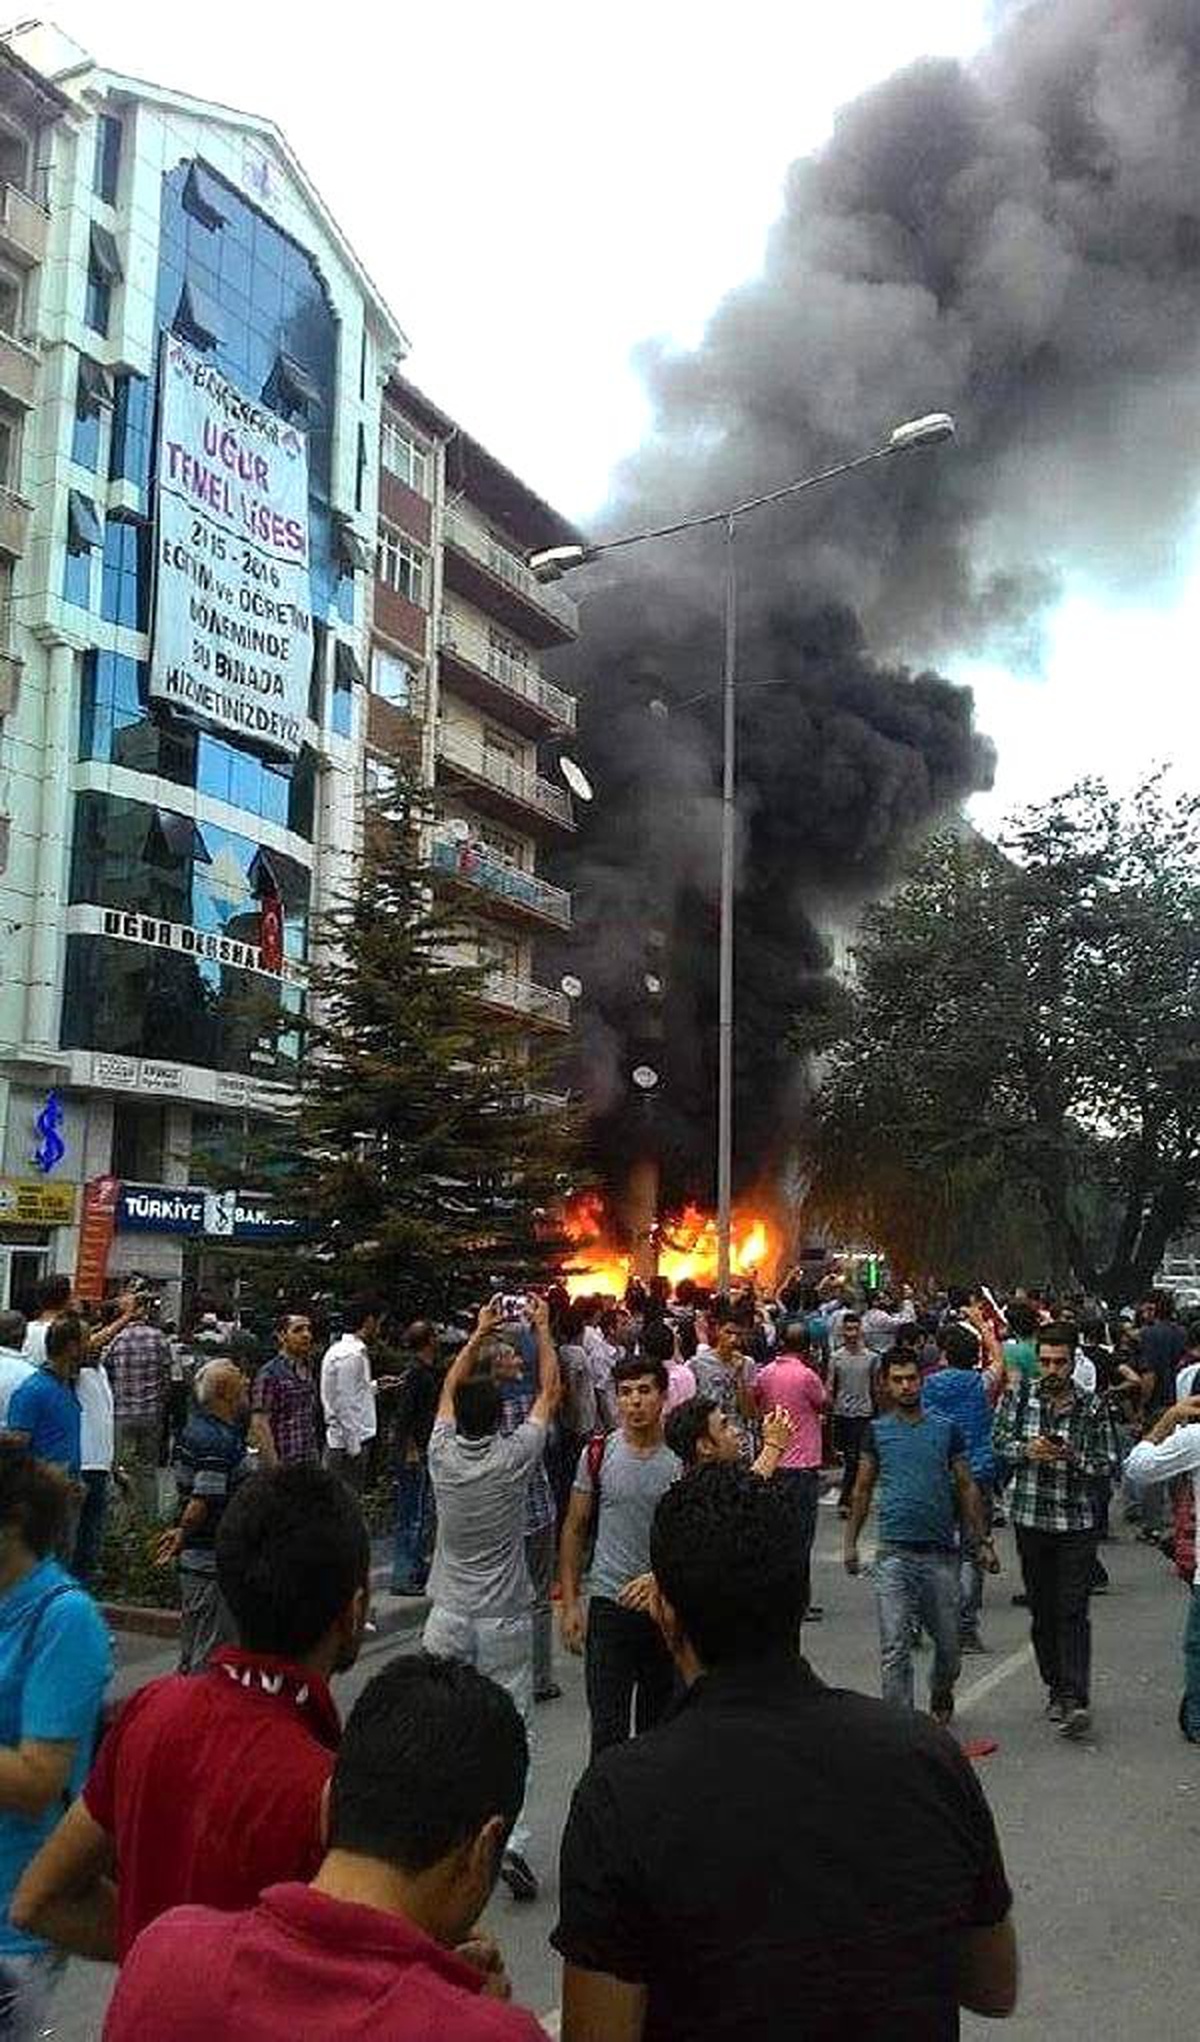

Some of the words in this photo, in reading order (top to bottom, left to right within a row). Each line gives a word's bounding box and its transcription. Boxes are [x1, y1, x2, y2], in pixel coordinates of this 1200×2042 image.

[167, 441, 233, 517] TEMEL
[204, 418, 269, 492] UĞUR
[242, 551, 280, 588] 2016
[126, 1195, 201, 1220] TÜRKİYE
